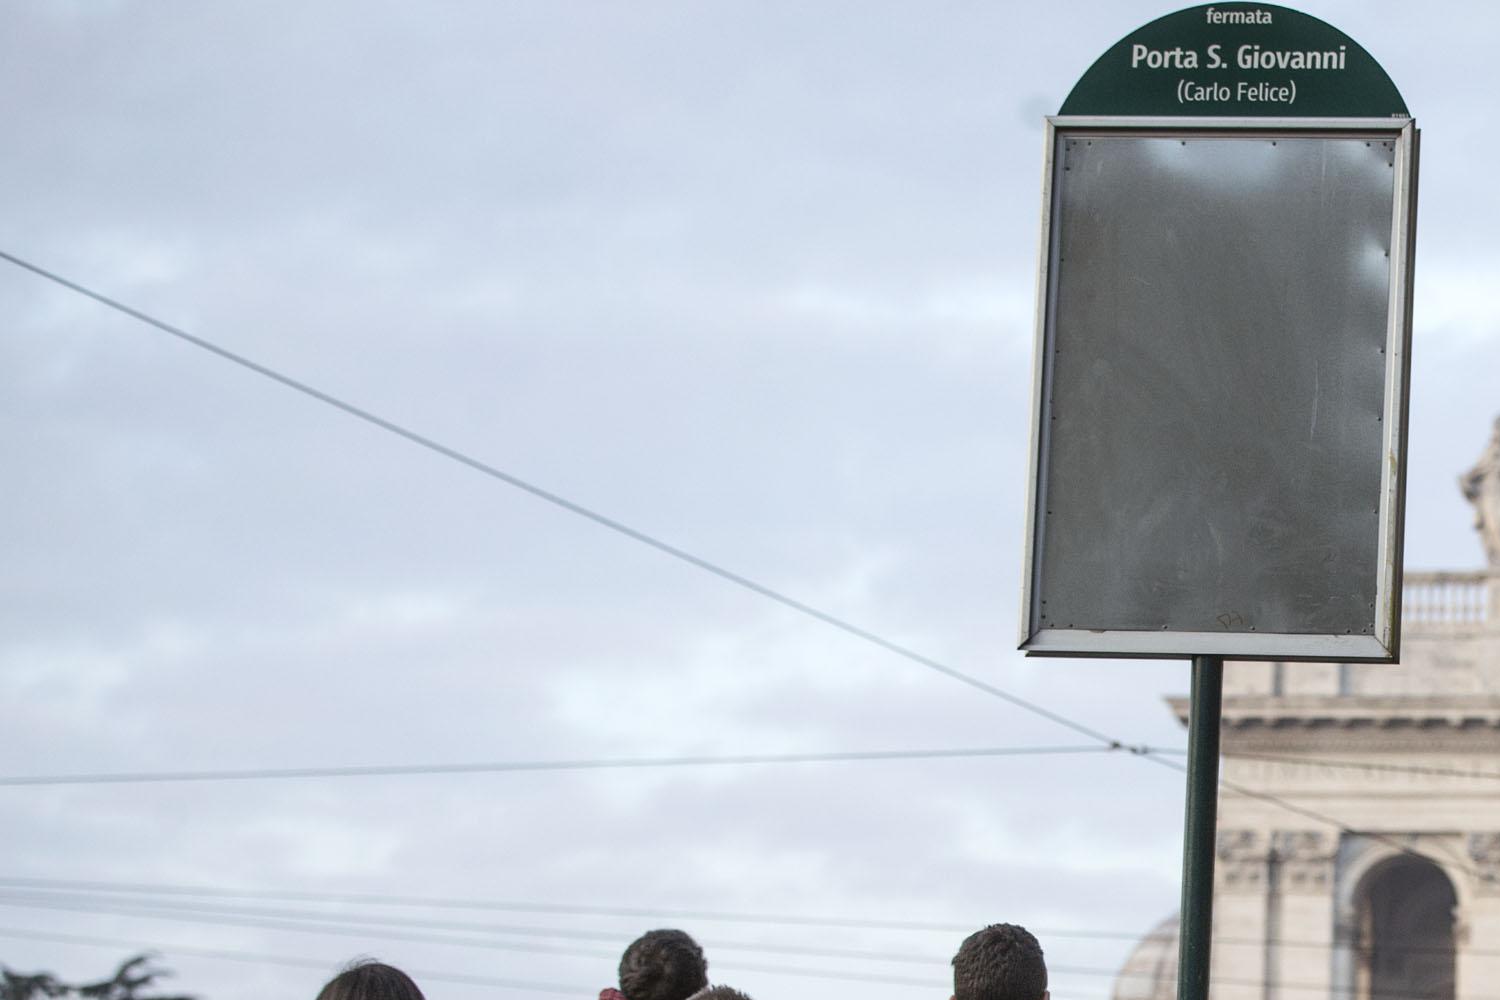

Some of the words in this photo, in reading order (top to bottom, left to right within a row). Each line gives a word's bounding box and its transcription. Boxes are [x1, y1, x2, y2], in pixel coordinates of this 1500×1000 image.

[1206, 8, 1272, 24] fermata
[1132, 44, 1198, 69] Porta
[1206, 44, 1228, 69] S.
[1237, 44, 1346, 69] Giovanni
[1177, 79, 1230, 104] (Carlo
[1237, 79, 1296, 104] Felice)
